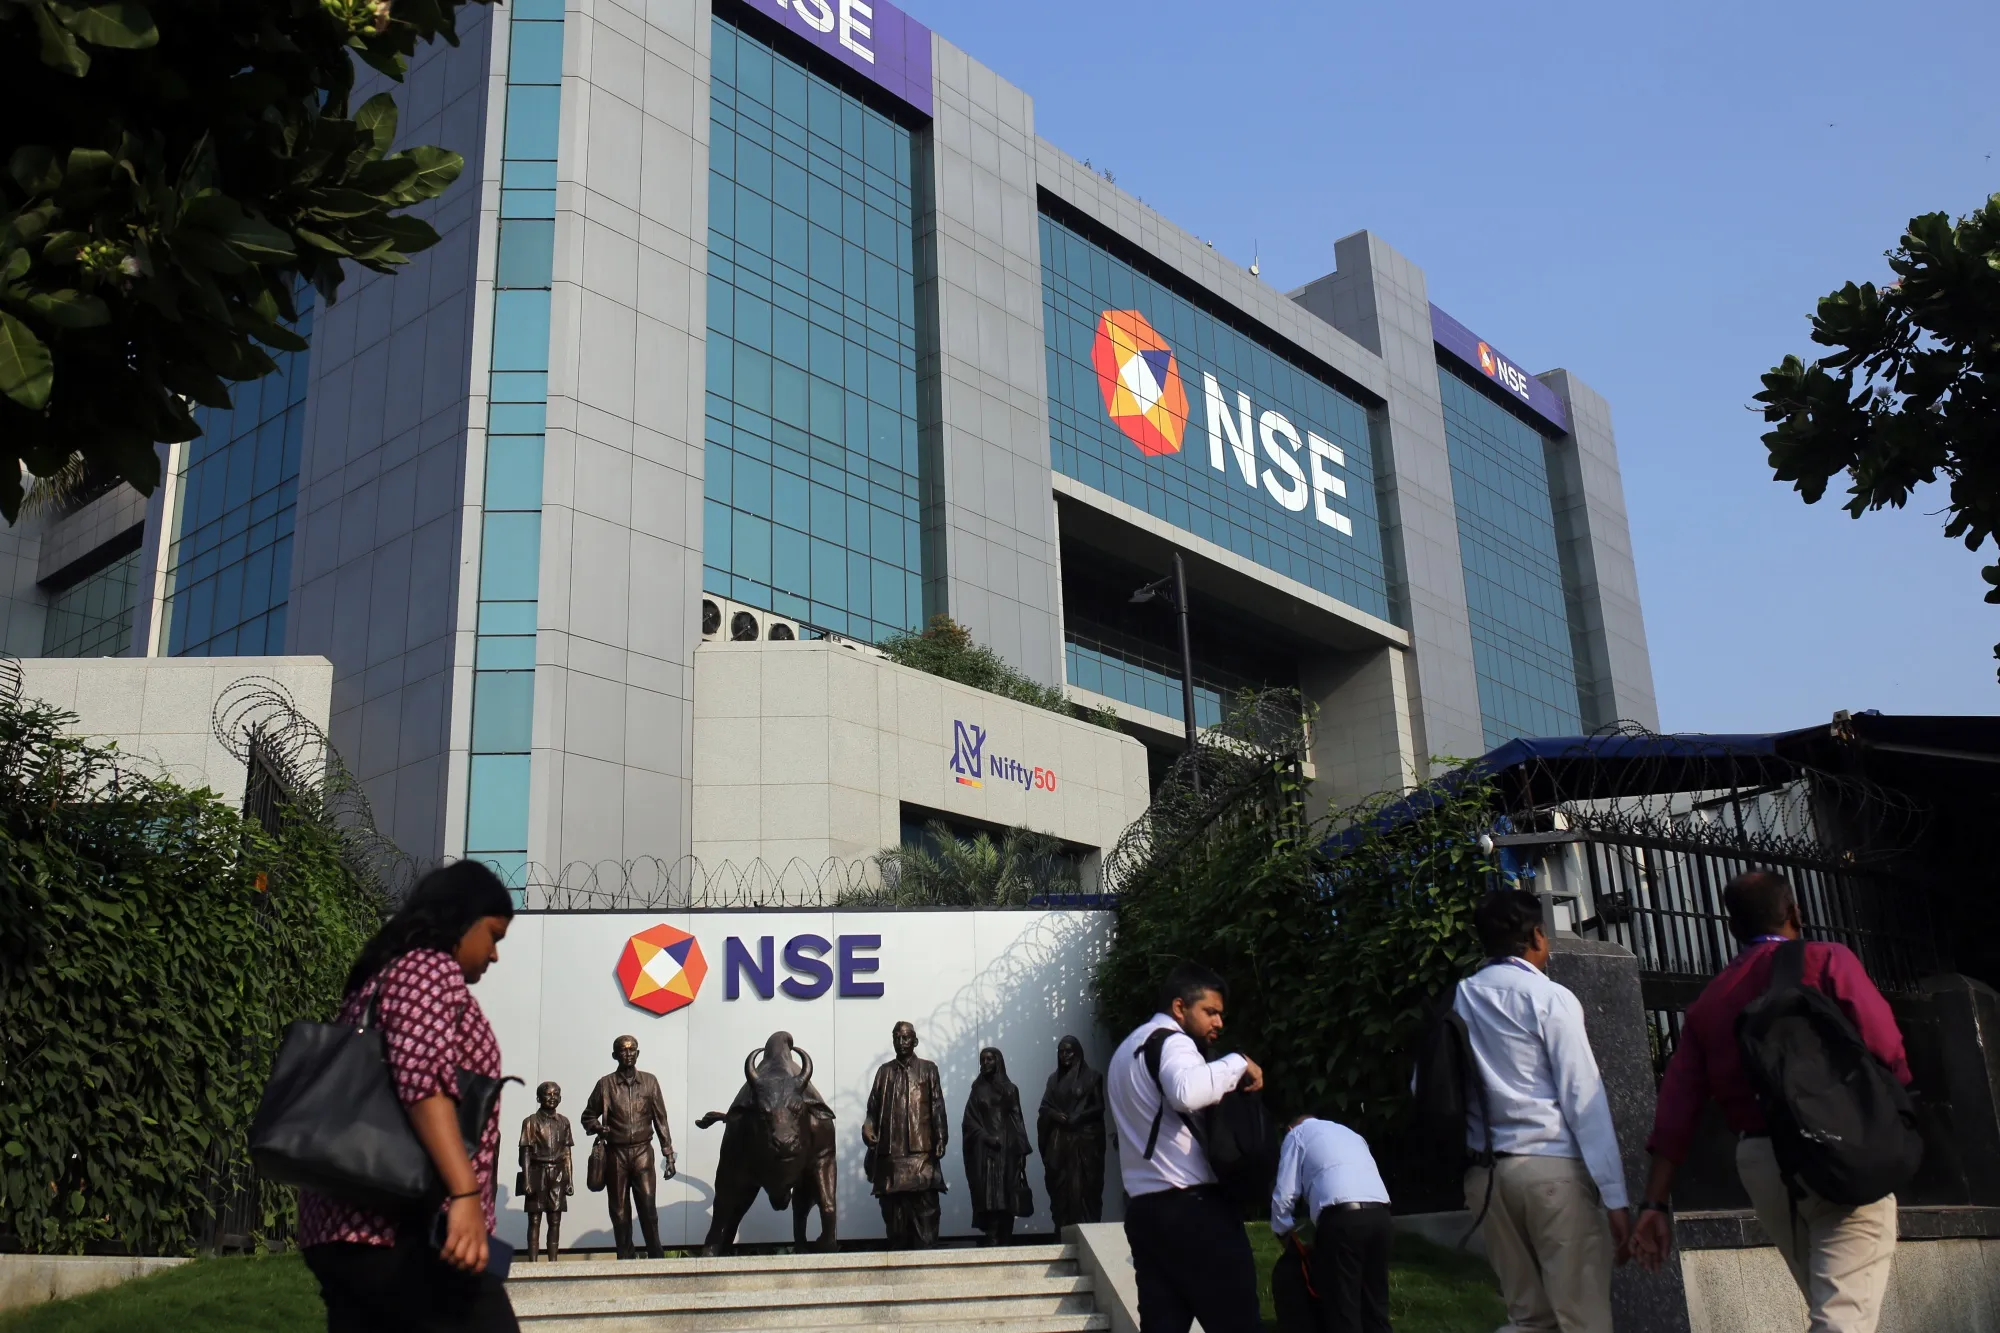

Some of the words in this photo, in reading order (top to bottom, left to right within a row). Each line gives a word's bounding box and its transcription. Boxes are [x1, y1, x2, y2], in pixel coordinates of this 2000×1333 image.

[1496, 356, 1530, 400] NSE
[1203, 371, 1353, 537] NSE
[990, 754, 1057, 792] Nifty50
[725, 933, 885, 1000] NSE
